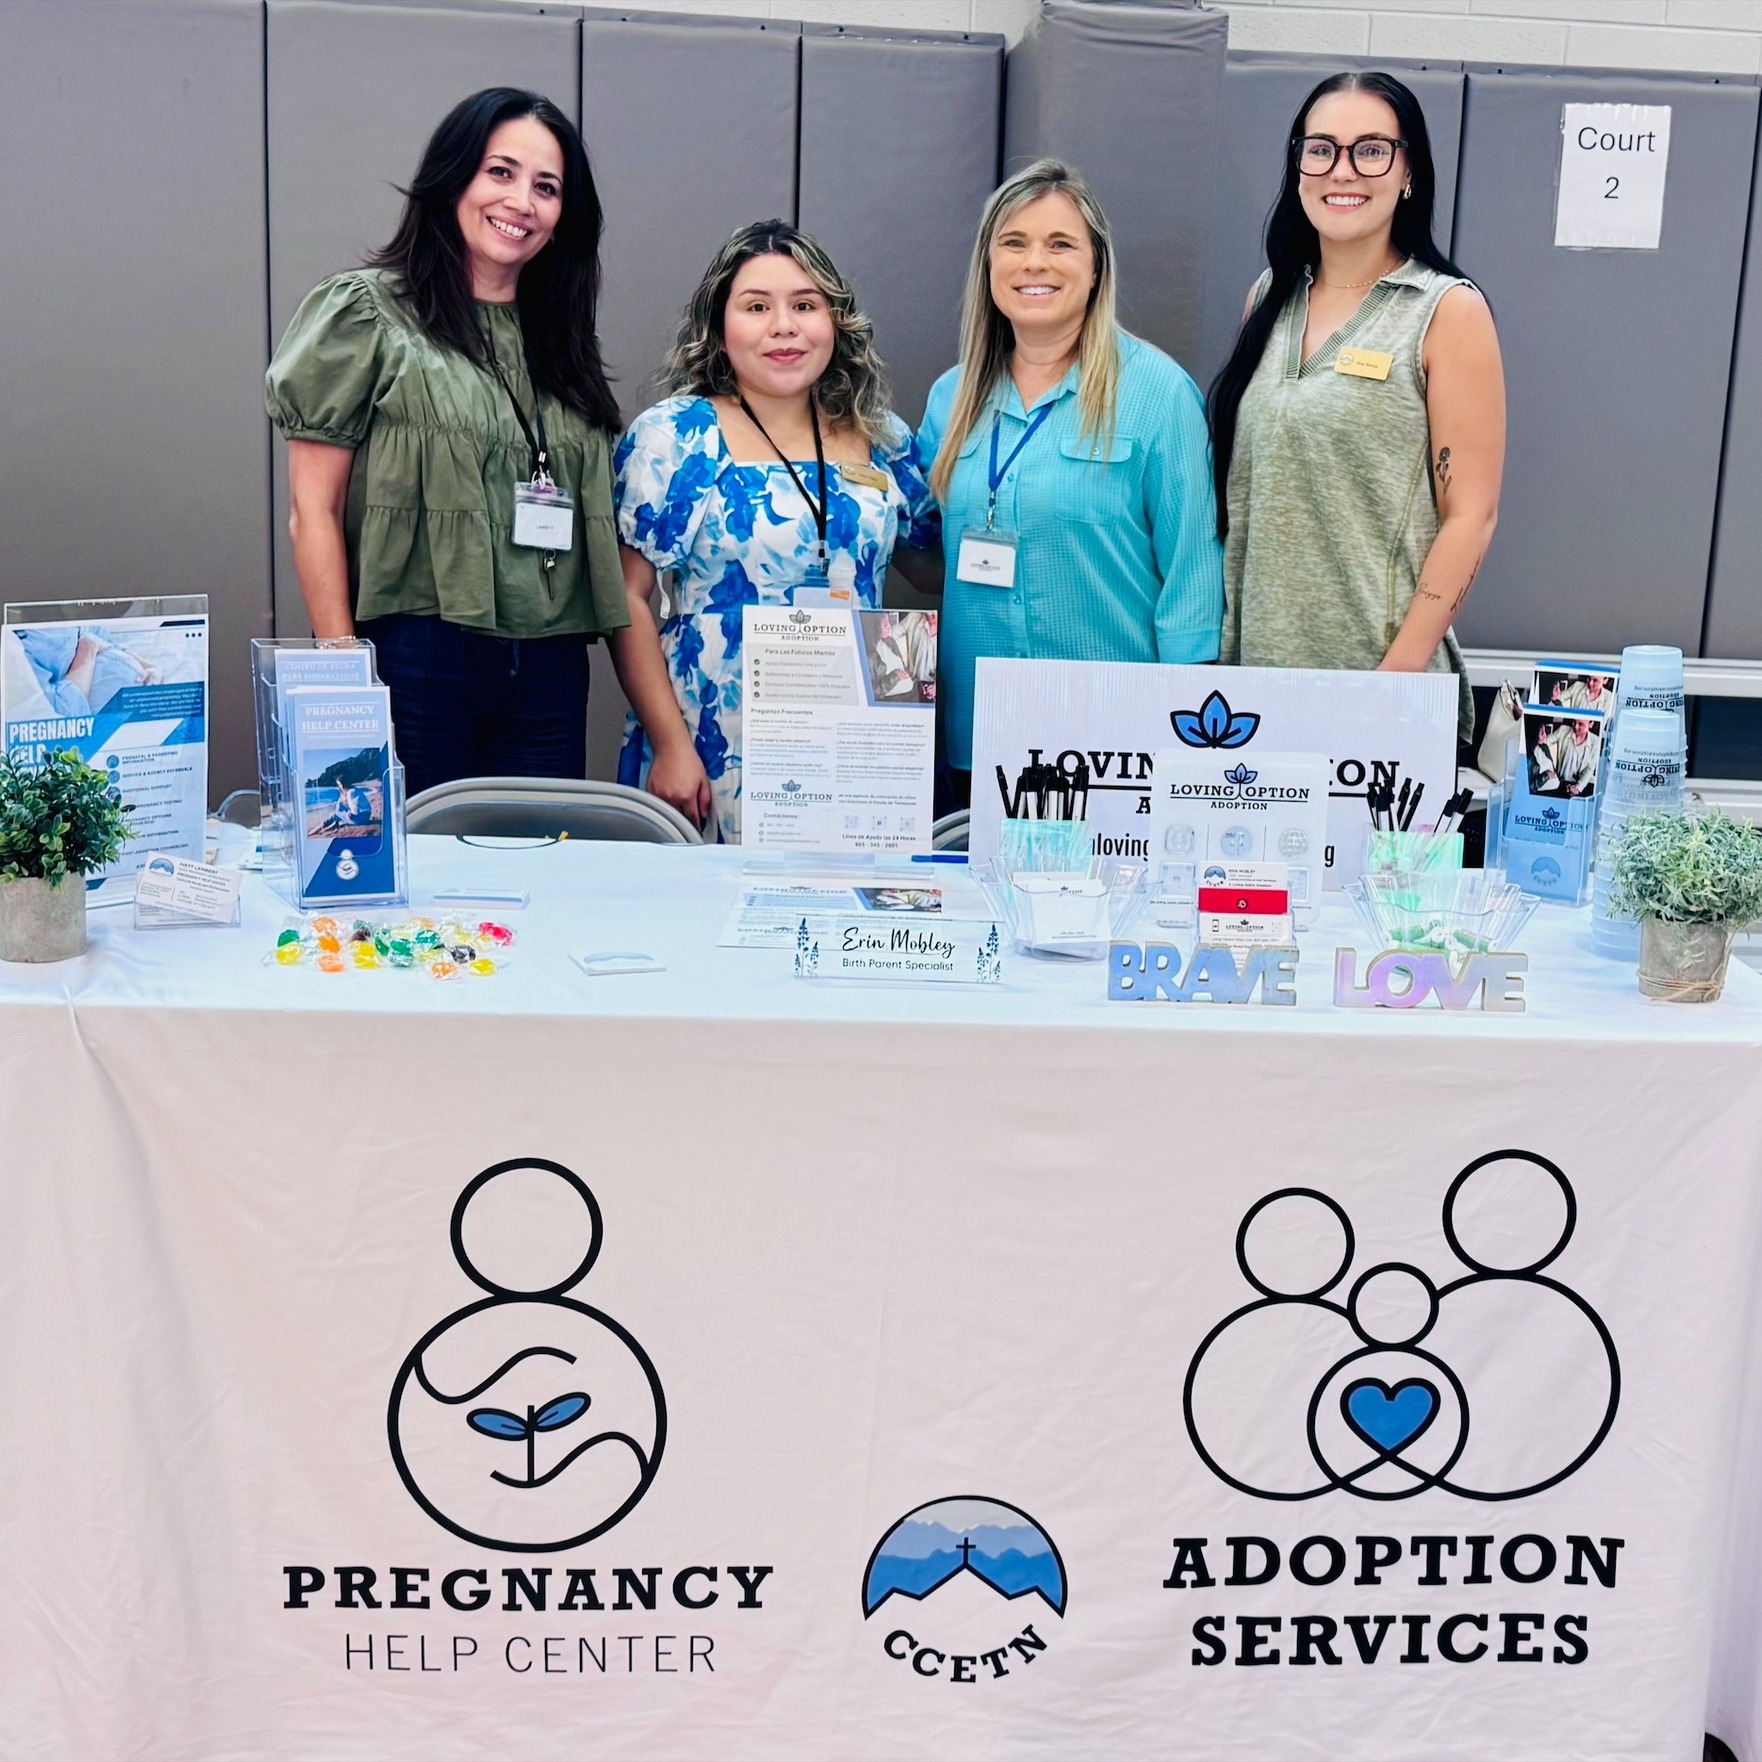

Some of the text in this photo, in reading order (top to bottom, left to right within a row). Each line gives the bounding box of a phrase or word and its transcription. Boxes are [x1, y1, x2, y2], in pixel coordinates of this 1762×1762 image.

[1578, 127, 1656, 153] Court
[1604, 177, 1619, 199] 2
[754, 624, 846, 634] LOVING OPTION
[306, 705, 374, 716] PREGNANCY
[1625, 699, 1663, 709] OPTION
[9, 716, 95, 744] PREGNANCY
[302, 719, 379, 731] HELP CENTER
[1028, 749, 1154, 779] LOVIN
[1614, 761, 1652, 774] OPTION
[750, 791, 833, 801] LOVING OPTION
[1170, 784, 1310, 799] LOVING OPTION
[1210, 801, 1268, 810] ADOPTION
[1515, 815, 1547, 826] LOVING
[842, 926, 955, 959] Erin Mobley
[842, 957, 954, 972] Birth Parent Specialist
[1107, 940, 1300, 1005] BRAVE
[1333, 947, 1528, 1012] LOVE
[1162, 1534, 1625, 1588] ADOPTION
[283, 1566, 774, 1612] PREGNANCY
[1191, 1613, 1590, 1666] SERVICES
[345, 1633, 716, 1673] HELP CENTER
[883, 1623, 1048, 1684] CCETN
